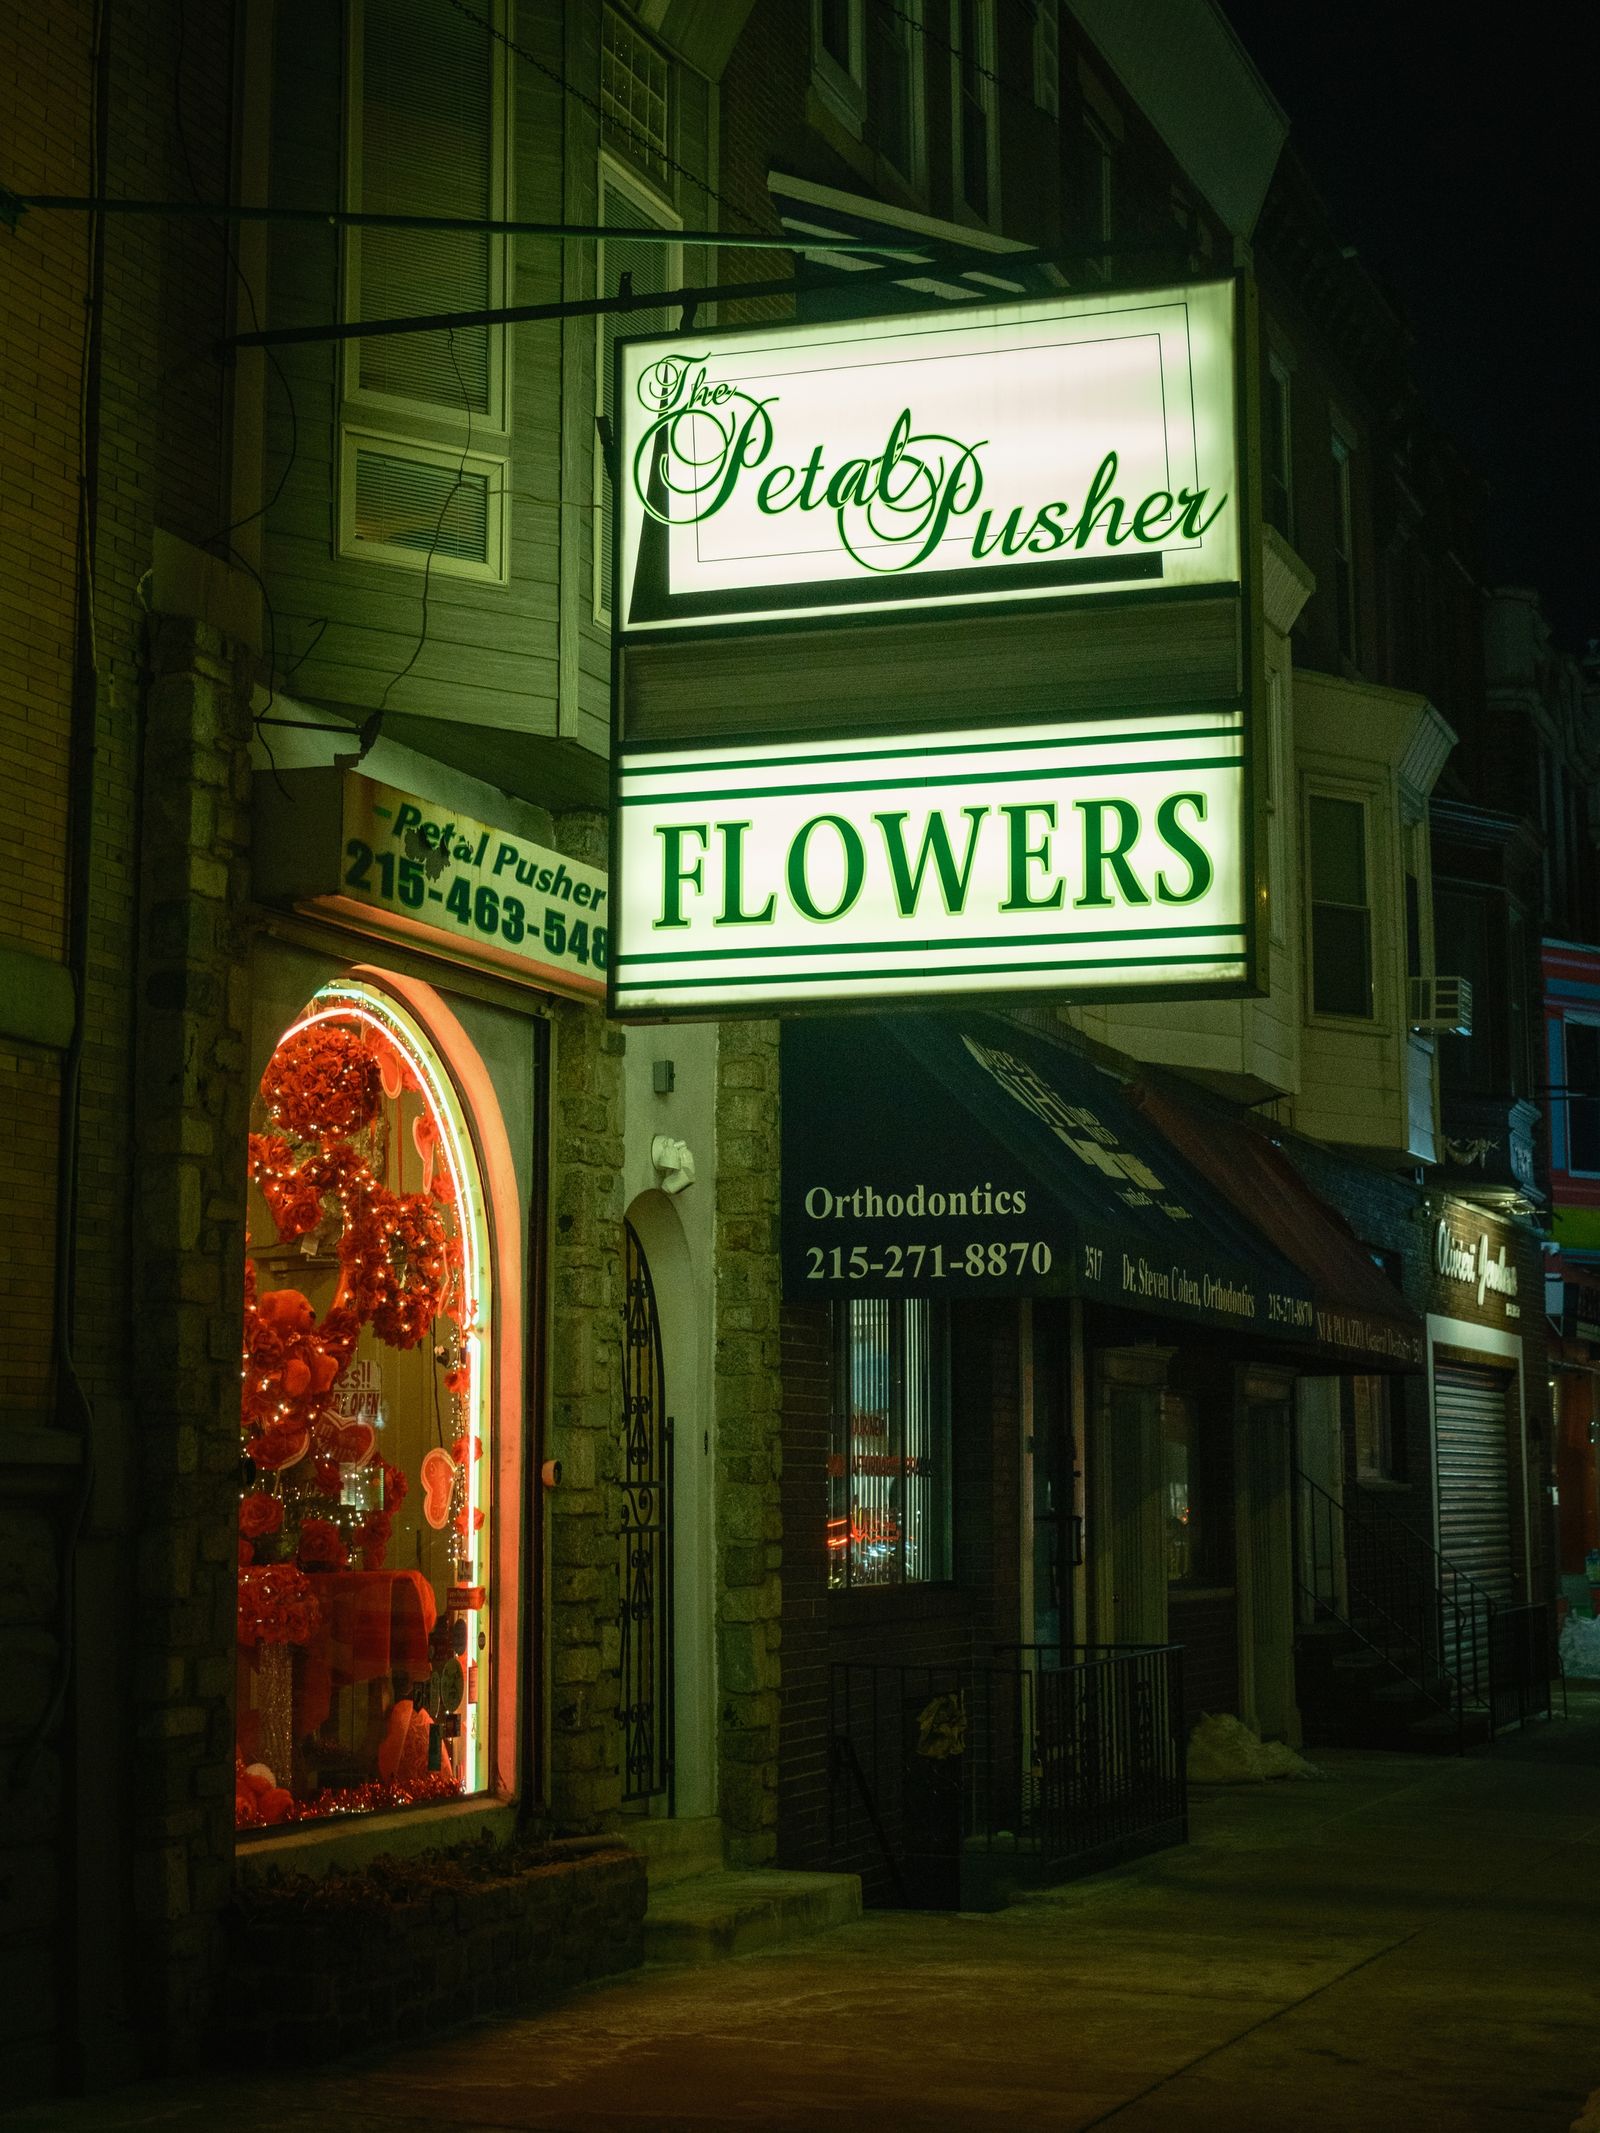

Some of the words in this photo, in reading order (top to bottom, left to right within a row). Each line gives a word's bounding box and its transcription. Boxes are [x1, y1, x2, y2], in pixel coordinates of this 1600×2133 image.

[637, 352, 737, 413] The
[633, 390, 914, 526] Petal
[837, 434, 1228, 573] Pusher
[492, 842, 607, 912] Pusher
[652, 790, 1214, 931] FLOWERS
[804, 1182, 1027, 1219] Orthodontics
[806, 1241, 1052, 1279] 215-271-8870
[1085, 1244, 1103, 1281] 2517
[1122, 1253, 1137, 1292] Dr.
[1138, 1257, 1169, 1299] Steven
[1171, 1266, 1200, 1311] Cohen,
[1203, 1273, 1255, 1318] Orthodontics
